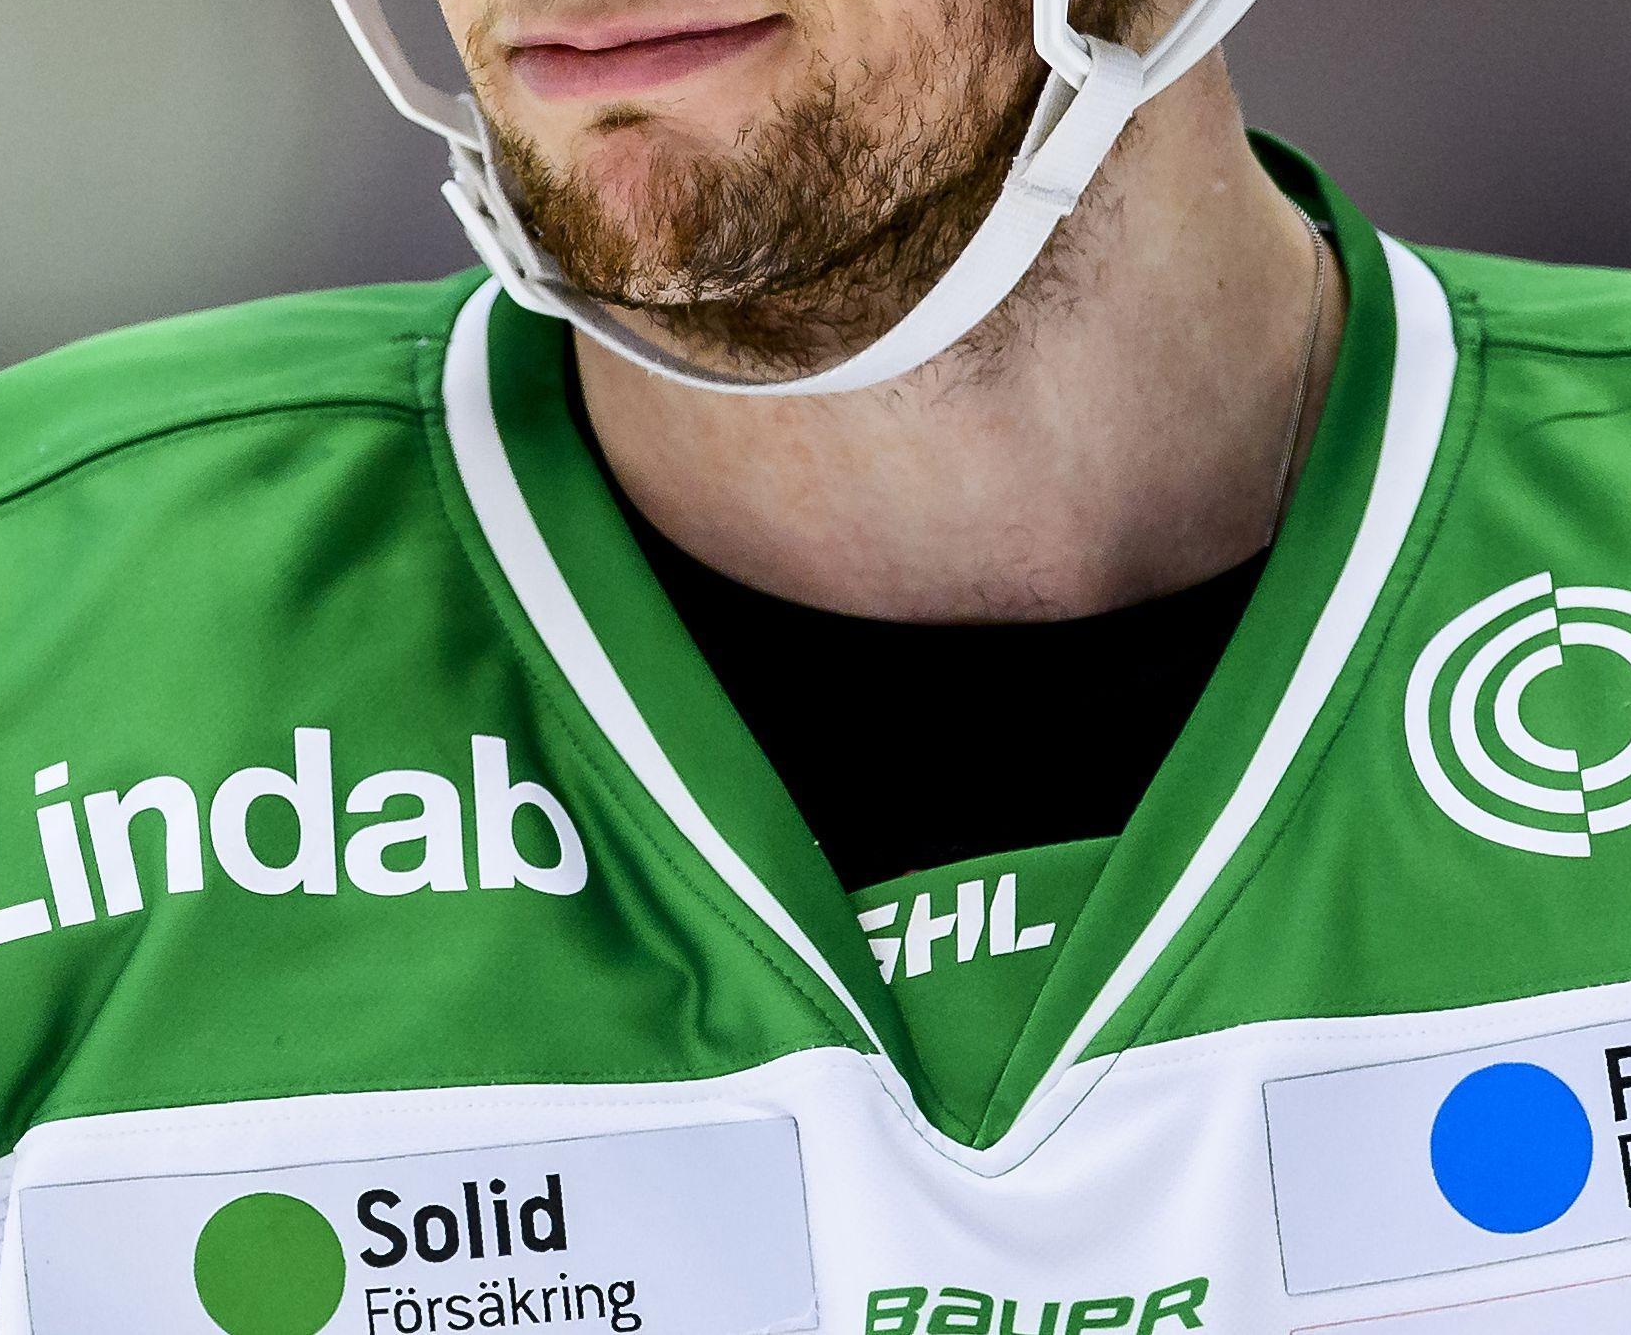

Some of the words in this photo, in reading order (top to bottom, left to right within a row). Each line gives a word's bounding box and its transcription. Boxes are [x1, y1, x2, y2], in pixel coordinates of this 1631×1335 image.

[856, 872, 1057, 985] SHL
[356, 1173, 568, 1269] Solid
[364, 1272, 642, 1335] Försäkring
